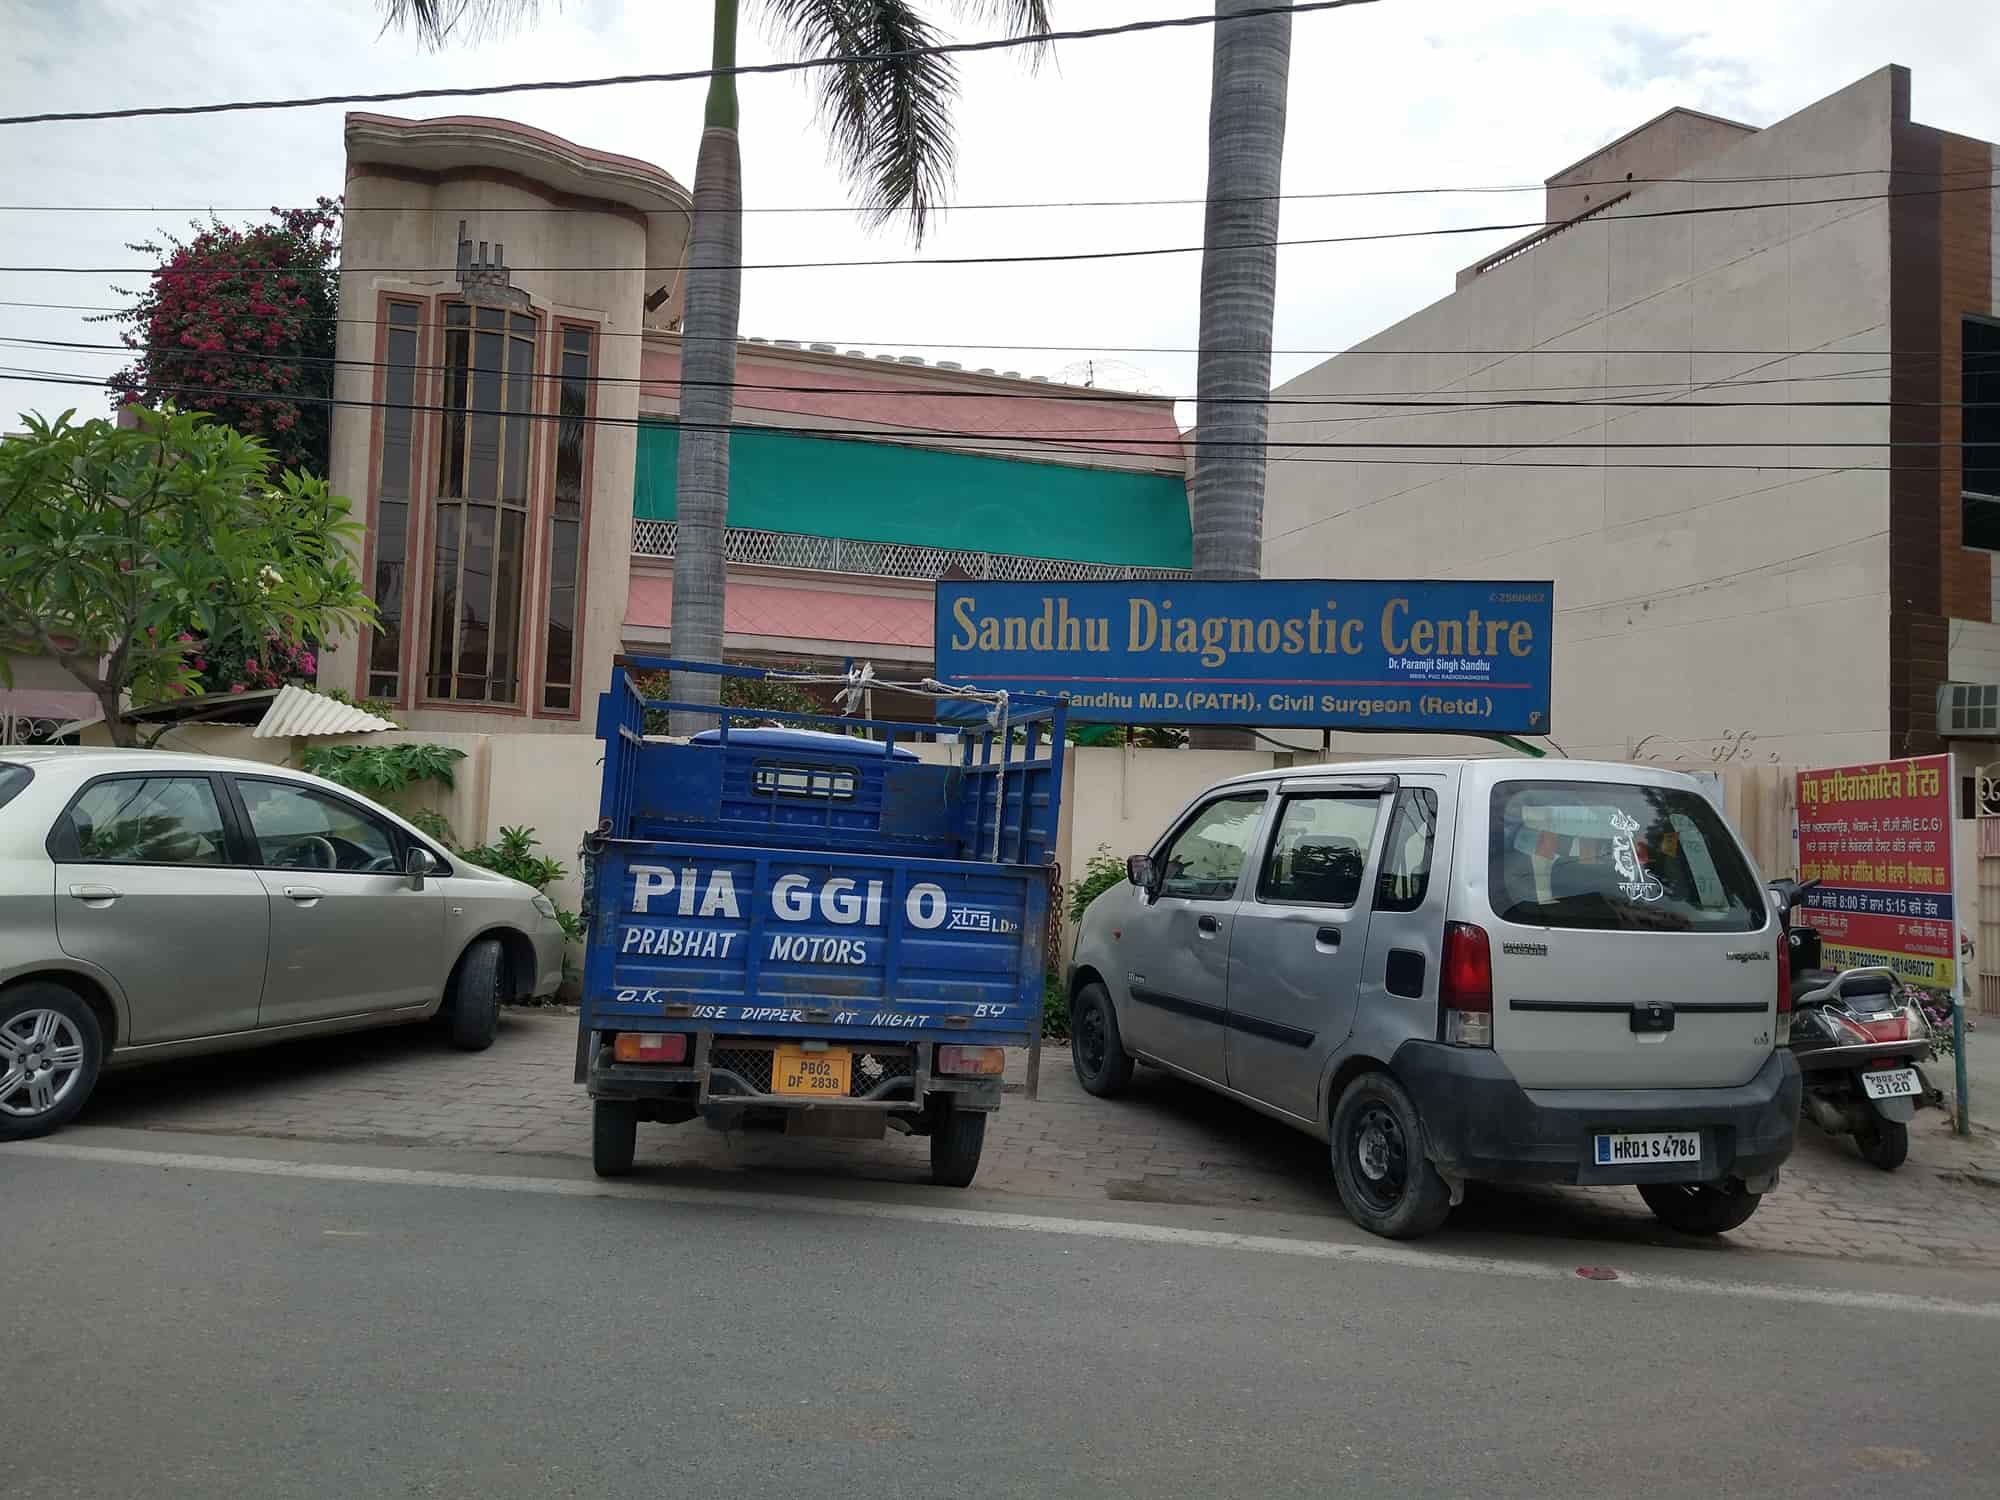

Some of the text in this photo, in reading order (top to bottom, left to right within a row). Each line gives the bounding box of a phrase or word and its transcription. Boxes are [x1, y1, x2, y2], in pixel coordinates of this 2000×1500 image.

[952, 597, 1534, 668] Sandhu Diagnostic Centre
[1388, 657, 1490, 673] Dr. Paramjit Singh Sandhu
[1268, 694, 1314, 712] Civil
[1321, 695, 1411, 717] Surgeon
[1420, 695, 1493, 717] (Retd.)
[1839, 895, 1857, 909] 8:00
[1886, 898, 1906, 913] 5:15
[622, 927, 867, 966] PRABHAT MOTORS
[692, 1005, 930, 1027] USE DIPPER AT NIGHT
[800, 1061, 831, 1076] PB02
[787, 1075, 839, 1089] DF 2838
[1876, 1081, 1911, 1095] 3120
